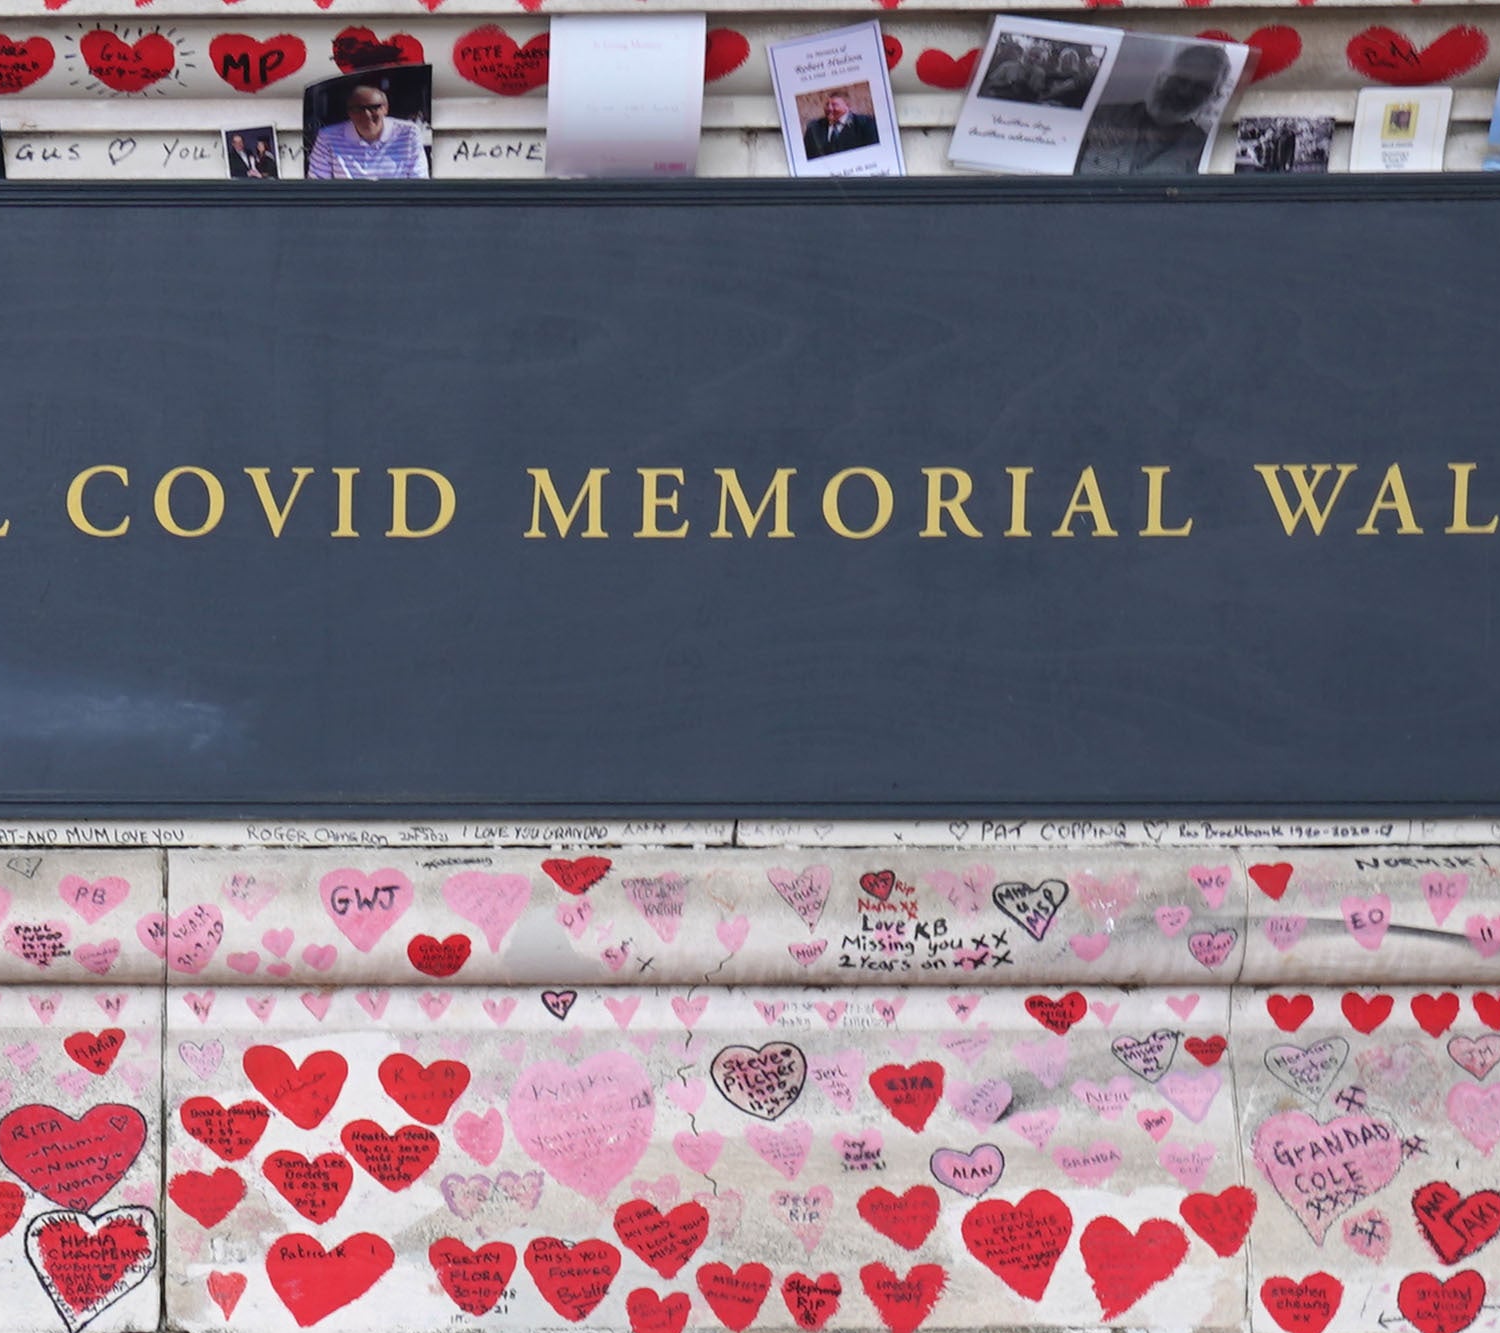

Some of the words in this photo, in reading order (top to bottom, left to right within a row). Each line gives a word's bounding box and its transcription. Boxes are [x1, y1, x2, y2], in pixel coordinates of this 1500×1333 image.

[223, 49, 284, 83] MP
[452, 140, 541, 162] ALONE
[66, 465, 455, 538] COVID
[525, 466, 1192, 539] MEMORIAL
[65, 826, 108, 842] MUM
[113, 829, 147, 842] LOVE
[152, 828, 183, 842] YOU
[981, 822, 1024, 841] PAT
[331, 886, 400, 915] GWJ
[861, 914, 905, 932] Love
[913, 919, 947, 940] KB
[842, 936, 914, 959] Missing
[927, 939, 963, 957] you
[840, 956, 853, 969] 2
[859, 955, 910, 972] Years
[921, 958, 947, 970] on
[12, 1121, 62, 1140] RITA
[952, 1166, 992, 1179] ALAN
[1295, 1161, 1360, 1193] COLE
